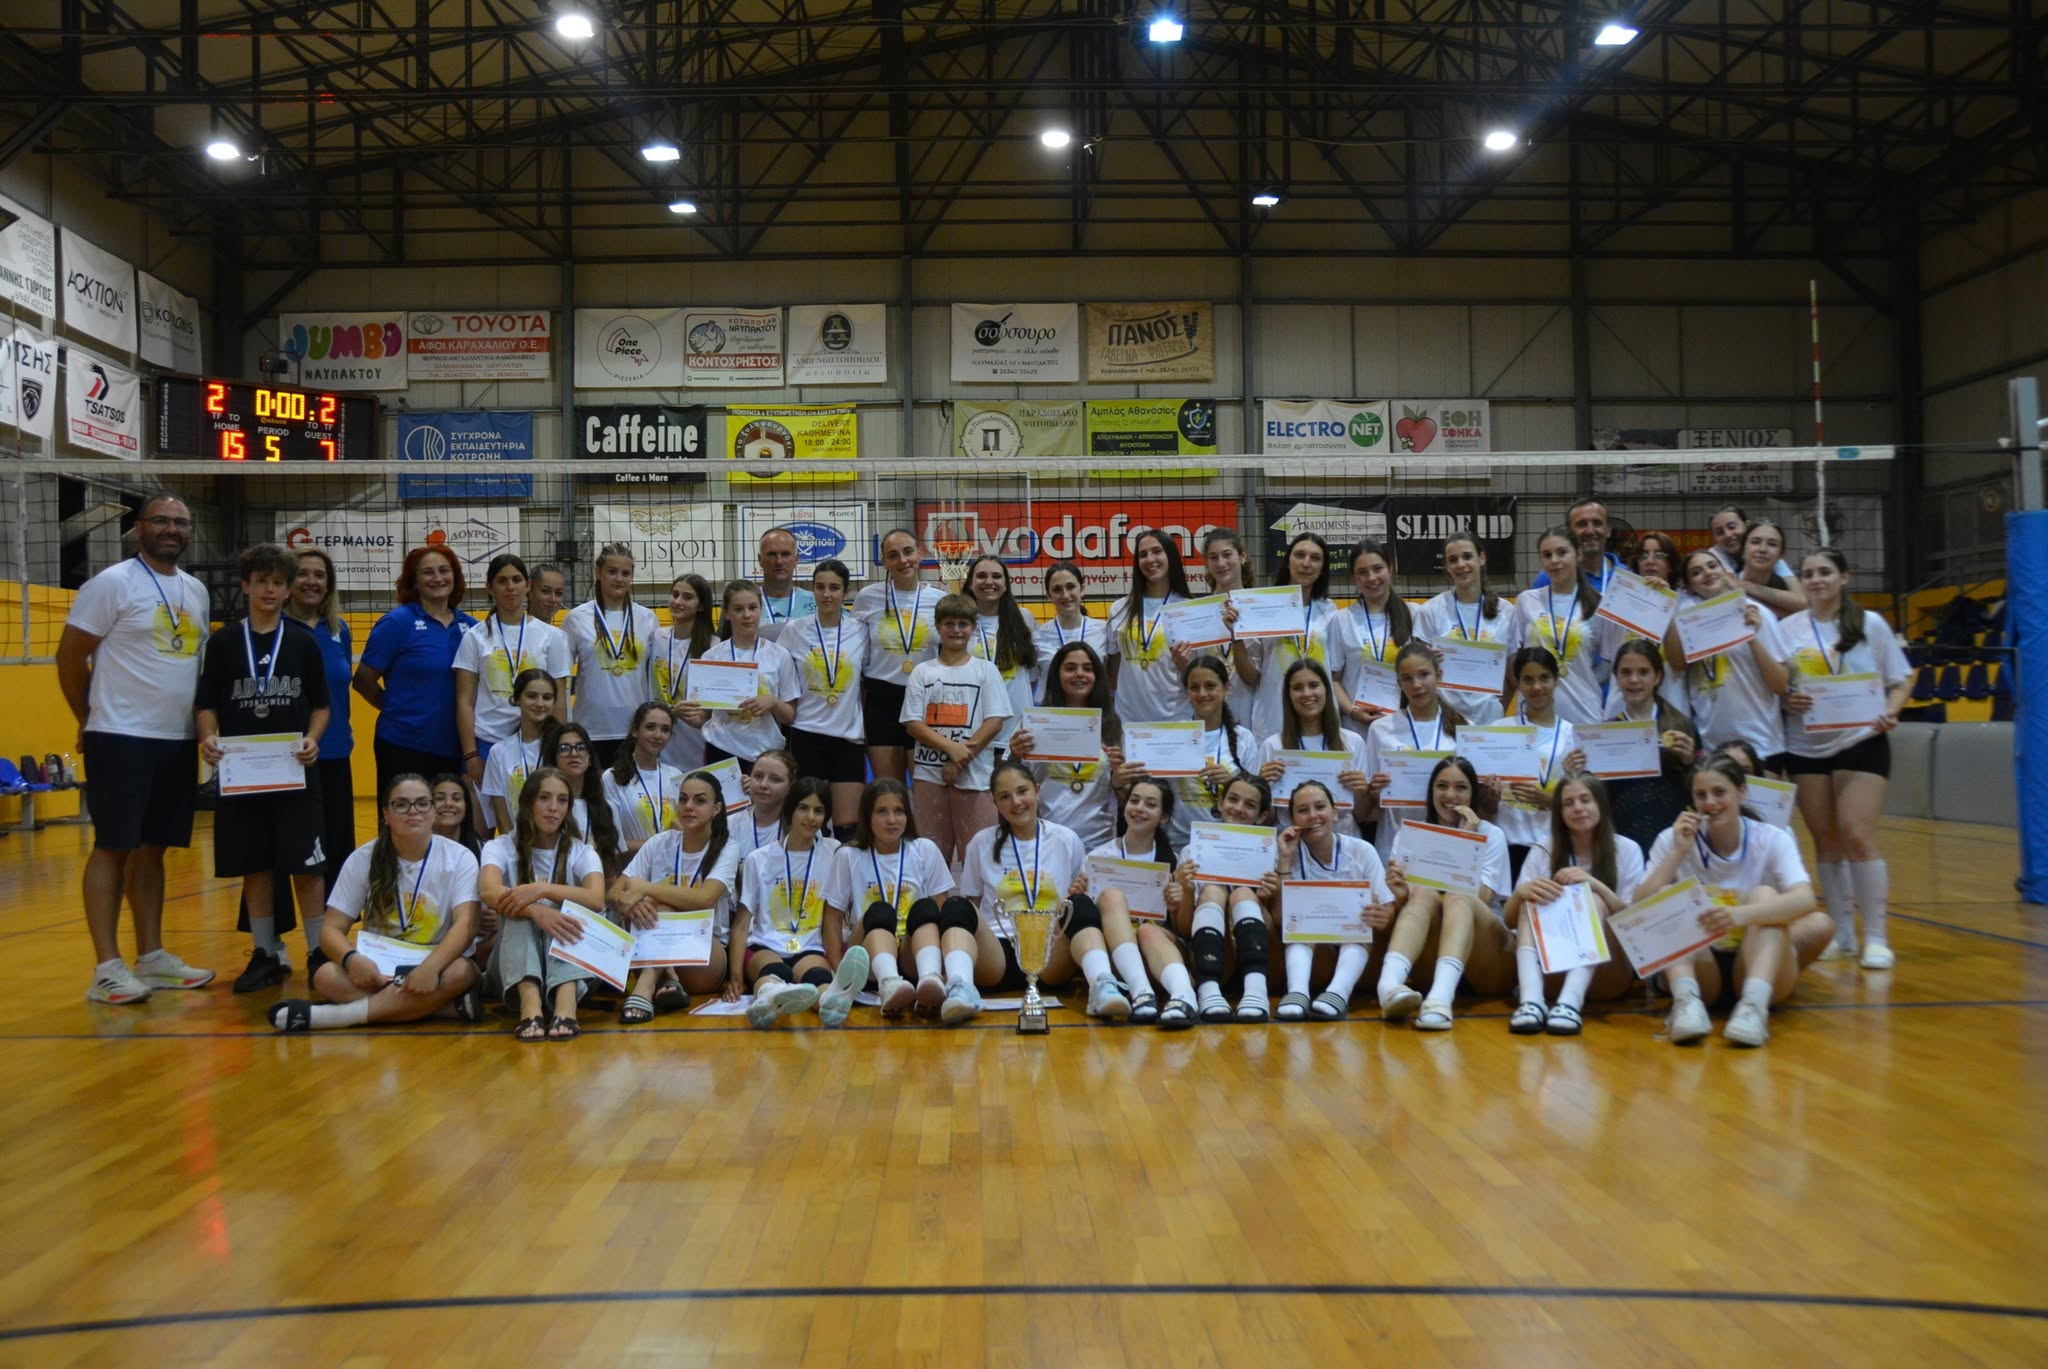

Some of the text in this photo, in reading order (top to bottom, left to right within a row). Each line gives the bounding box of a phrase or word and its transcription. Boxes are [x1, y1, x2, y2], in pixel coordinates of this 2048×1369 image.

[452, 315, 546, 332] TOYOTA
[729, 325, 777, 333] ΝΑΥΠΑΚΤΟΥ
[1108, 315, 1184, 346] ΠΑΝΟΣ
[284, 322, 402, 362] JUMBO
[418, 341, 447, 352] ΑΦΟΙ
[448, 339, 515, 351] ΚΑΡΑΧΑΛΙΟΥ
[618, 338, 638, 347] One
[614, 346, 642, 356] Piece
[689, 356, 778, 368] ΚΟΝΤΟΧΡΗΣΤΟΣ
[305, 367, 382, 380] ΝΑΥΠΑΚΤΟΥ
[208, 383, 225, 412] 2
[320, 396, 335, 423] 2
[85, 399, 126, 424] TSATSOS
[229, 414, 241, 422] TO
[214, 422, 241, 433] HOME
[258, 426, 290, 437] PERIOD
[308, 421, 319, 430] TO
[1266, 420, 1381, 438] ELECTRO NET
[305, 431, 333, 441] GUEST
[451, 432, 502, 440] ΣΥΓΧΡΟΝΑ
[586, 414, 698, 453] Caffeine
[798, 429, 851, 437] ΚΑΘΗΜΕΡΙΝΑ
[1692, 430, 1778, 448] ΞΕΝΙΟΣ
[223, 431, 245, 460] 15
[451, 442, 526, 451] ΕΚΠΑΙΔΕΥΤΗΡΙΑ
[831, 438, 851, 446] 24:00
[266, 435, 280, 462] 5
[320, 442, 335, 462] 7
[615, 474, 640, 482] Coffee
[648, 474, 669, 482] More
[1396, 514, 1473, 540] SLIDE
[315, 535, 394, 547] ΓΕΡΜΑΝΟΣ
[450, 530, 498, 542] ΔΟΥΡΟΣ
[1081, 570, 1117, 585] ηνών
